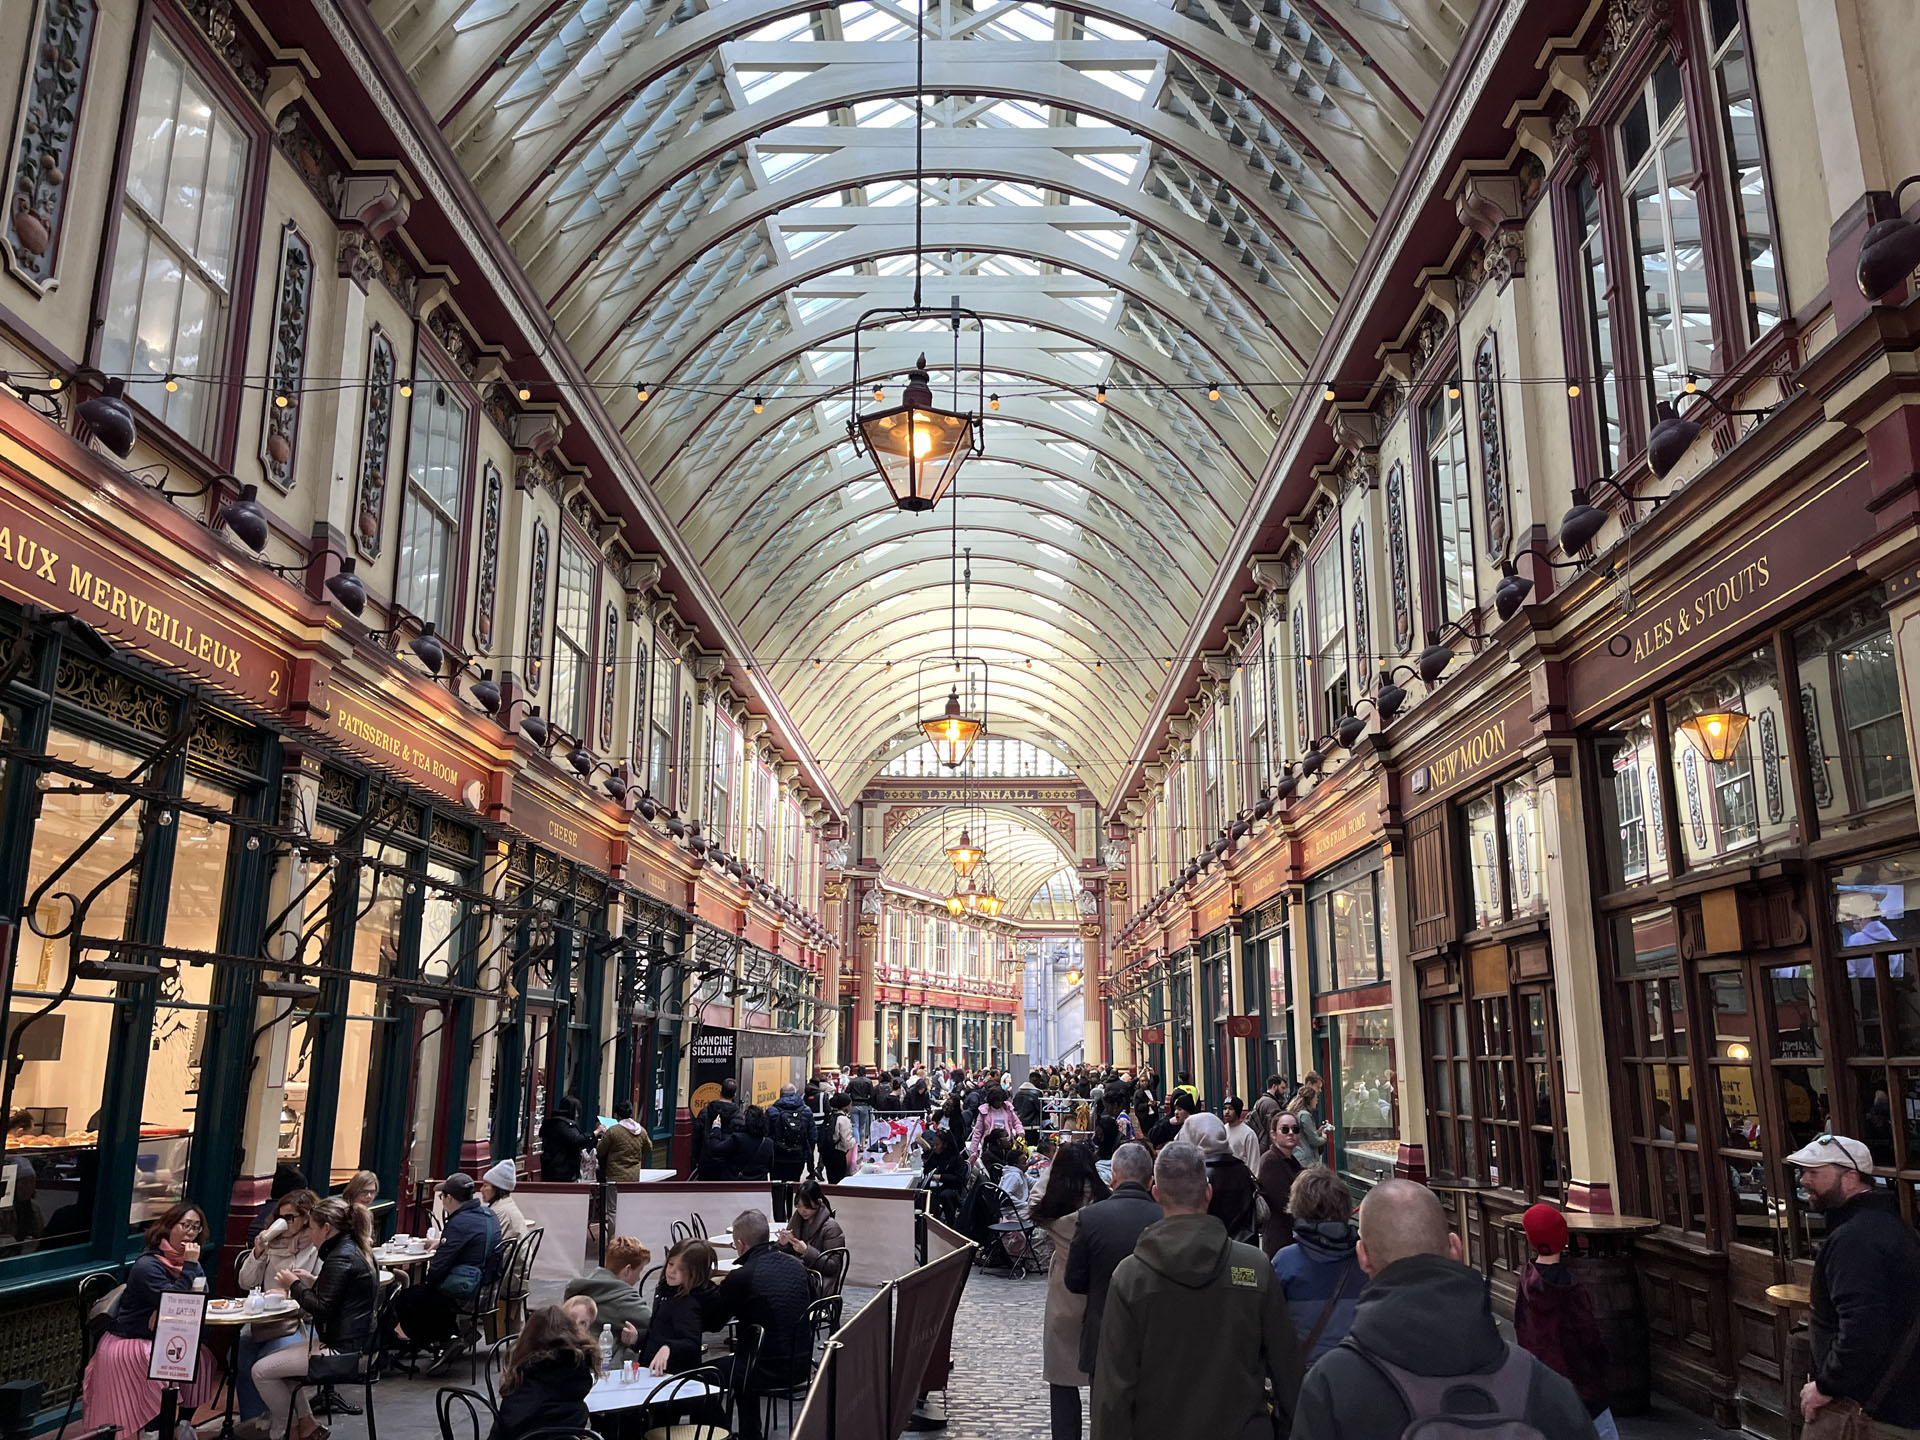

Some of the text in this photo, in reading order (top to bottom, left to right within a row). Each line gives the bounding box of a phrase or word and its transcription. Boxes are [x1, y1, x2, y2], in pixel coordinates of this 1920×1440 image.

[68, 564, 242, 678] MERVEILLEUX
[1634, 555, 1770, 664] ALES & STOUTS
[267, 670, 280, 697] 2
[337, 709, 458, 786] PATISSERIE & TEA ROOM
[1429, 719, 1506, 791] NEW MOON
[927, 790, 1034, 800] LEADENHALL
[548, 820, 578, 848] CHEESE
[1330, 824, 1347, 848] FROM
[1347, 811, 1367, 836] HOME
[692, 1046, 733, 1056] SICILIANE
